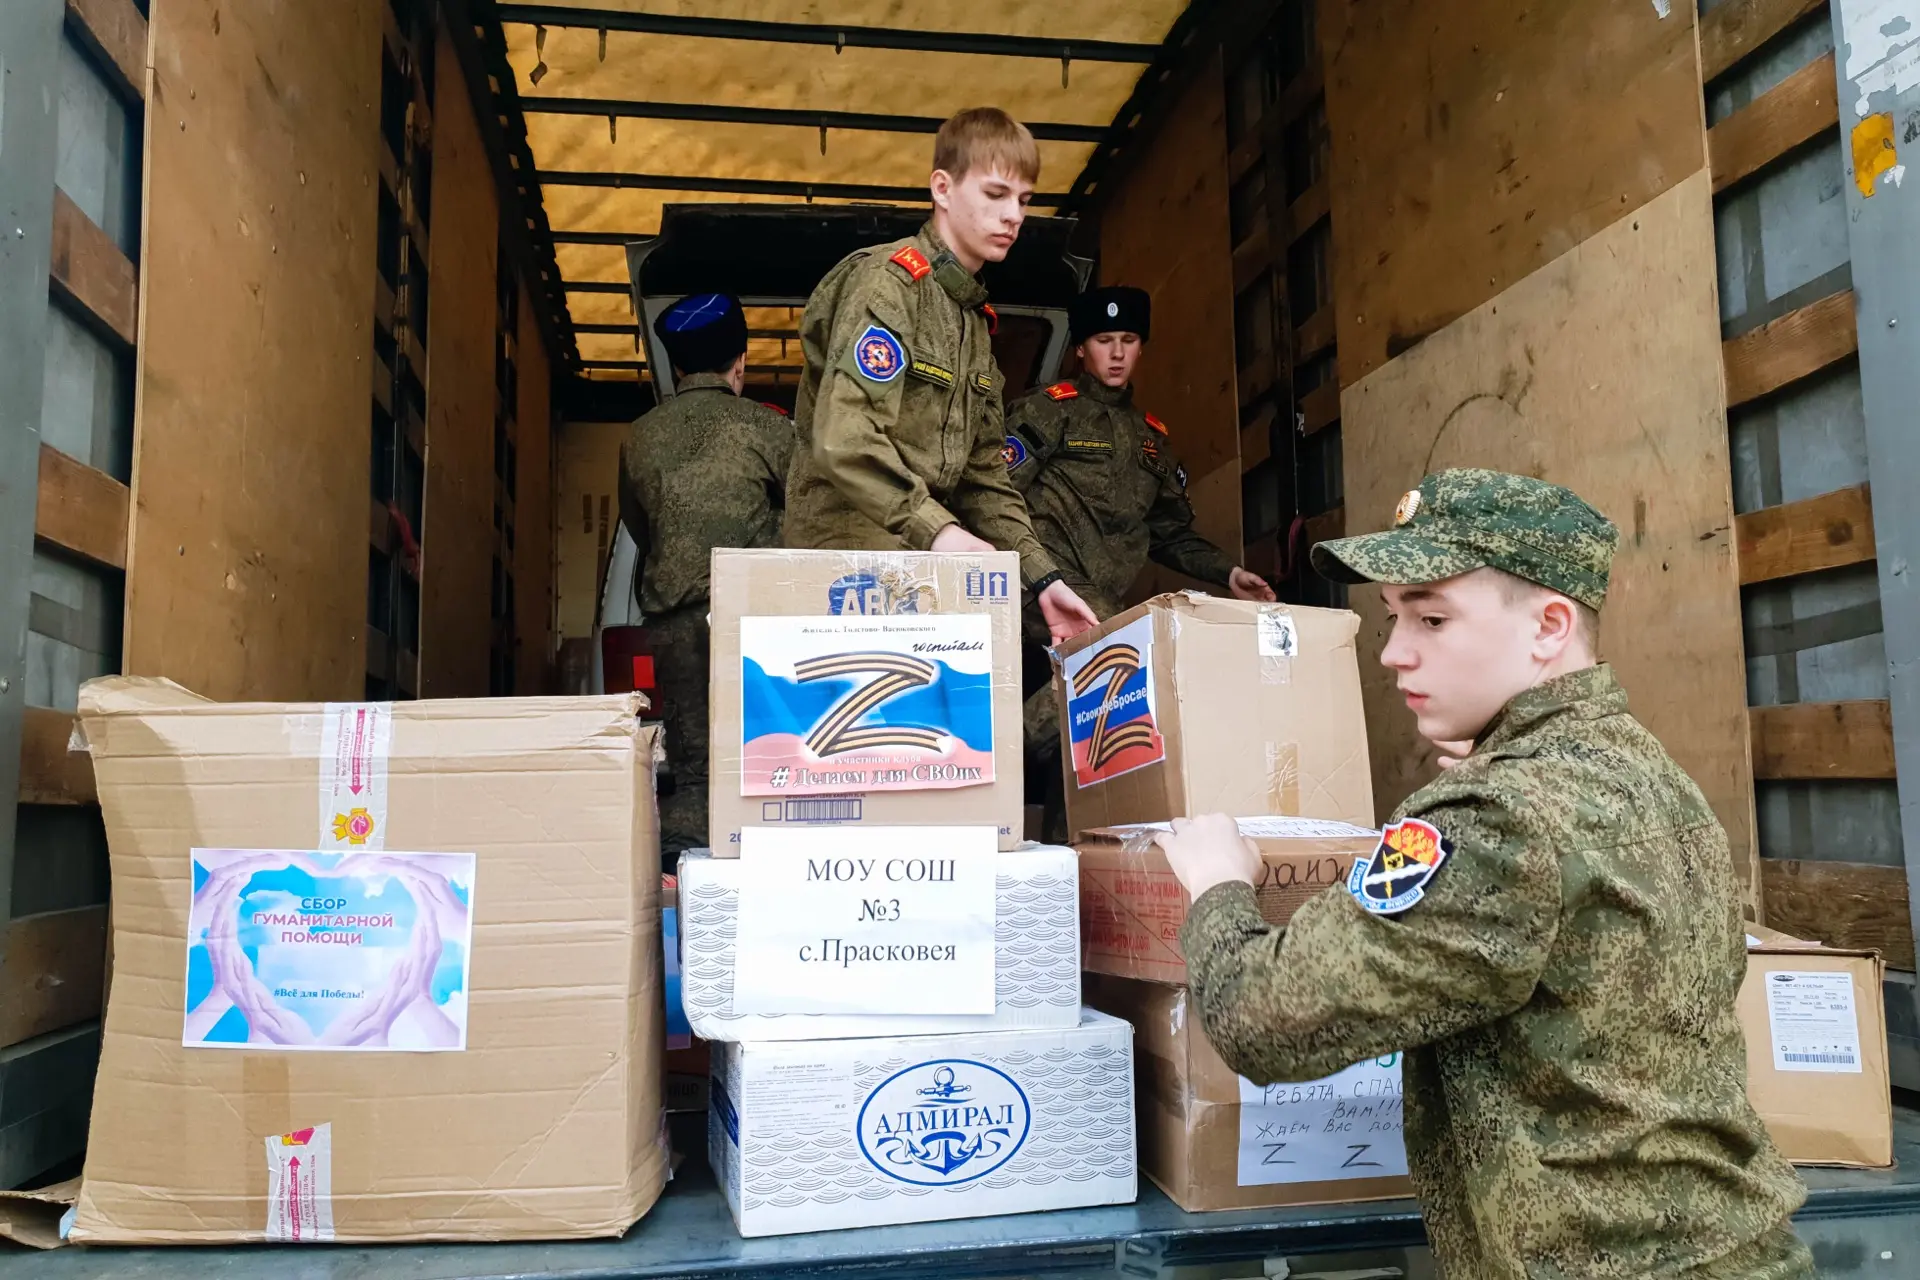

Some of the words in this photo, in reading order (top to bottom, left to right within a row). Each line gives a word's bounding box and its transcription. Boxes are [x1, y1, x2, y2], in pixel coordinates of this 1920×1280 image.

[838, 757, 890, 766] участники
[793, 767, 867, 788] Делаем
[871, 767, 907, 785] для
[911, 763, 983, 782] СВОих
[806, 858, 876, 882] МОУ
[885, 858, 956, 882] СОШ
[301, 897, 347, 910] СБОР
[858, 898, 901, 922] №3
[253, 913, 394, 927] ГУМАНИТАРНОЙ
[281, 931, 362, 945] ПОМОЩИ
[799, 938, 956, 968] с.Прасковея
[299, 989, 318, 999] для
[320, 989, 365, 999] Победы!
[873, 1104, 1015, 1138] АДМИРАЛ
[1323, 1118, 1353, 1133] ВАС
[1261, 1143, 1297, 1165] Z
[1340, 1144, 1383, 1168] Z
